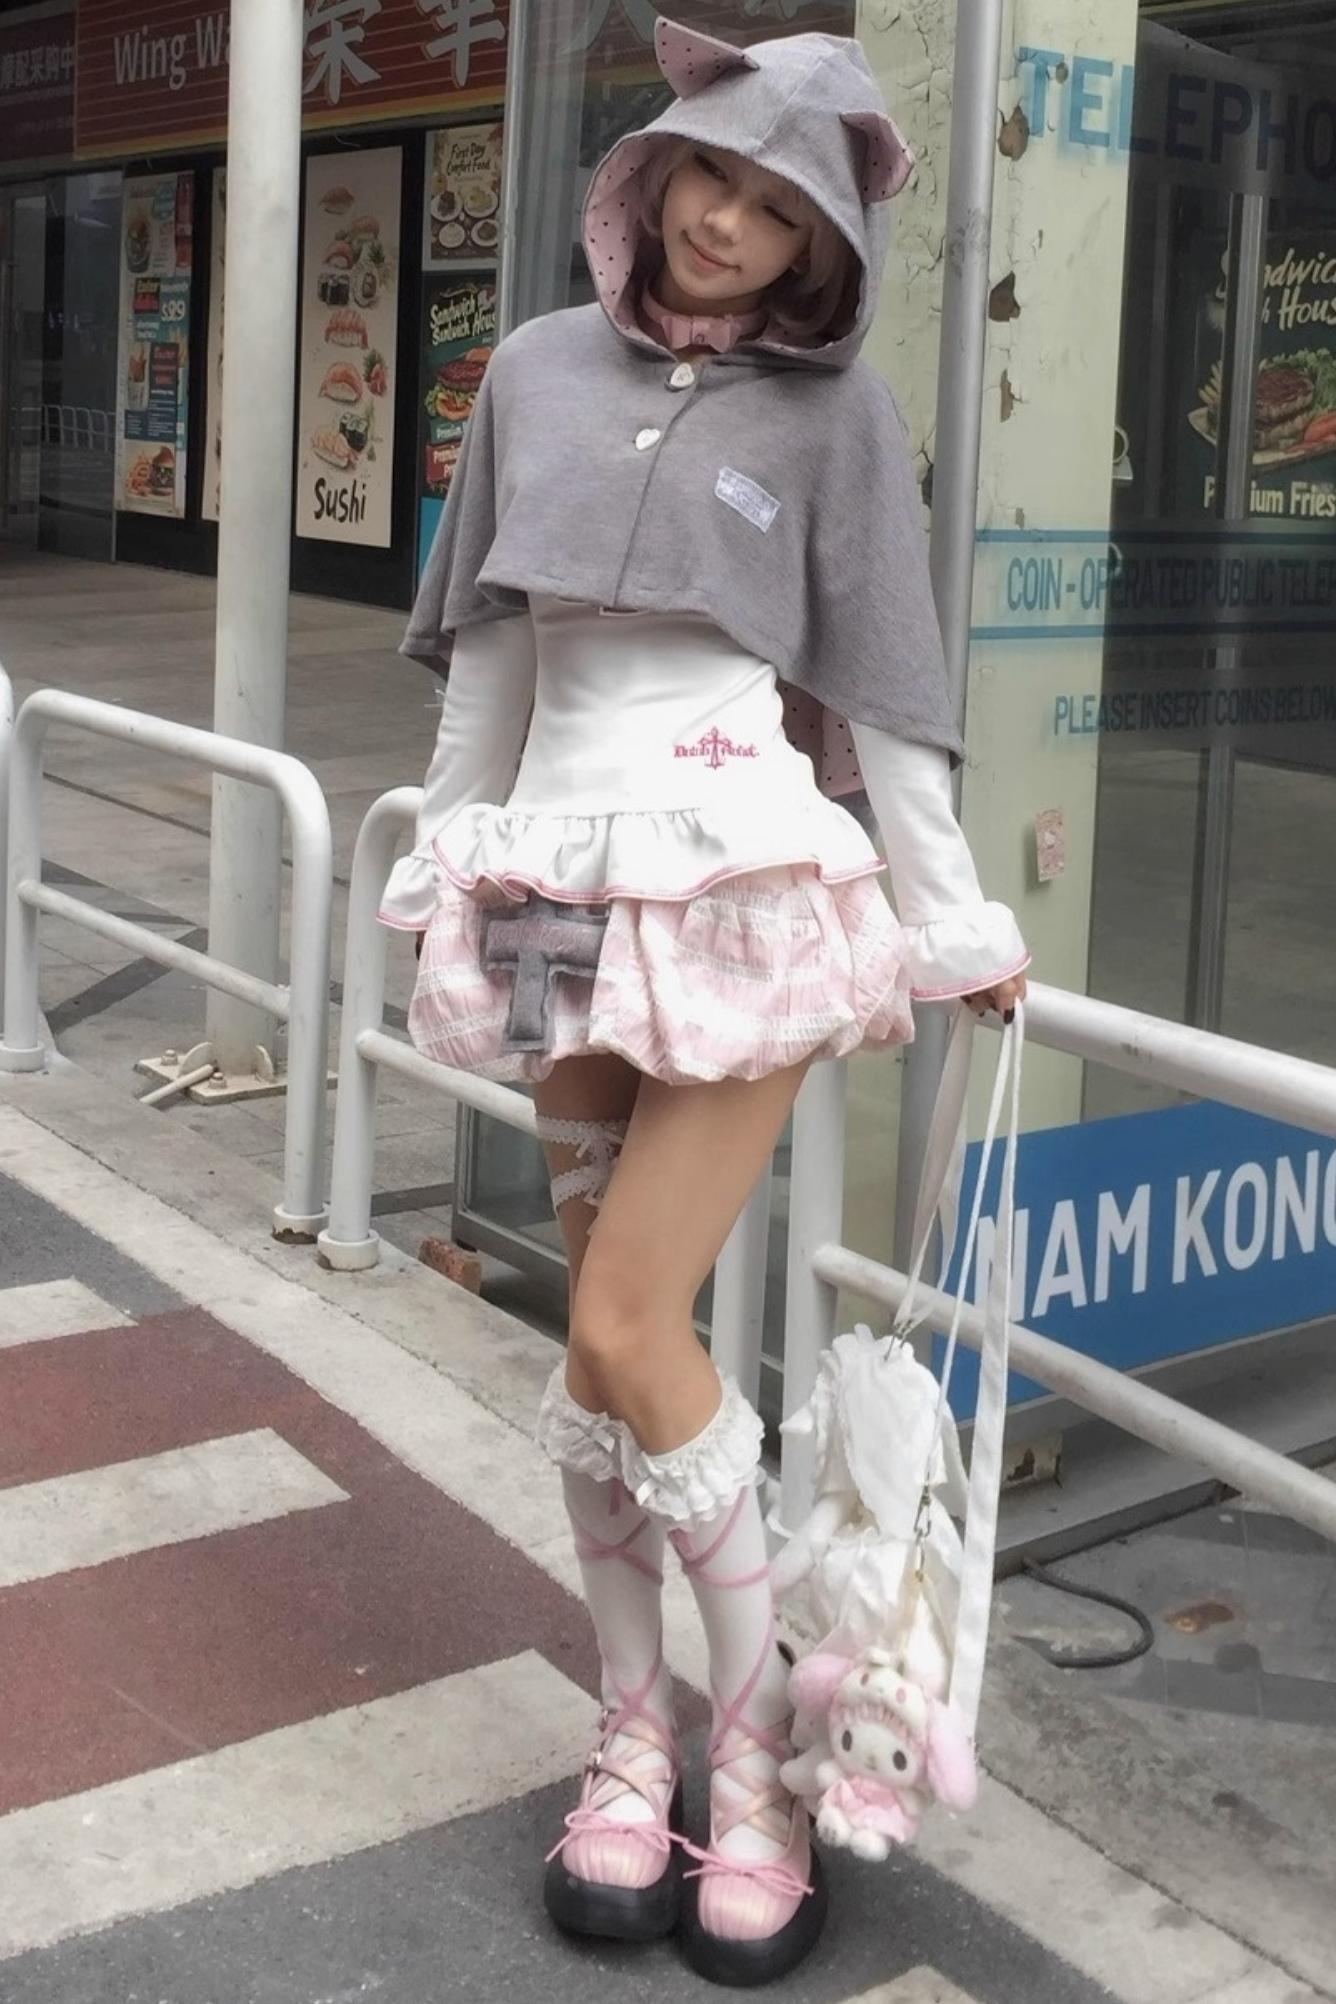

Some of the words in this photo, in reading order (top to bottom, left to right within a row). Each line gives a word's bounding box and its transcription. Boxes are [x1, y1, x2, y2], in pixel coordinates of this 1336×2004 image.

[114, 25, 187, 90] Wing
[429, 293, 476, 329] Sandwich
[311, 470, 353, 507] Sushi
[1290, 480, 1336, 518] Fries
[1054, 689, 1137, 736] PLEASE
[1139, 687, 1212, 731] INSERT
[1214, 686, 1271, 726] COINS
